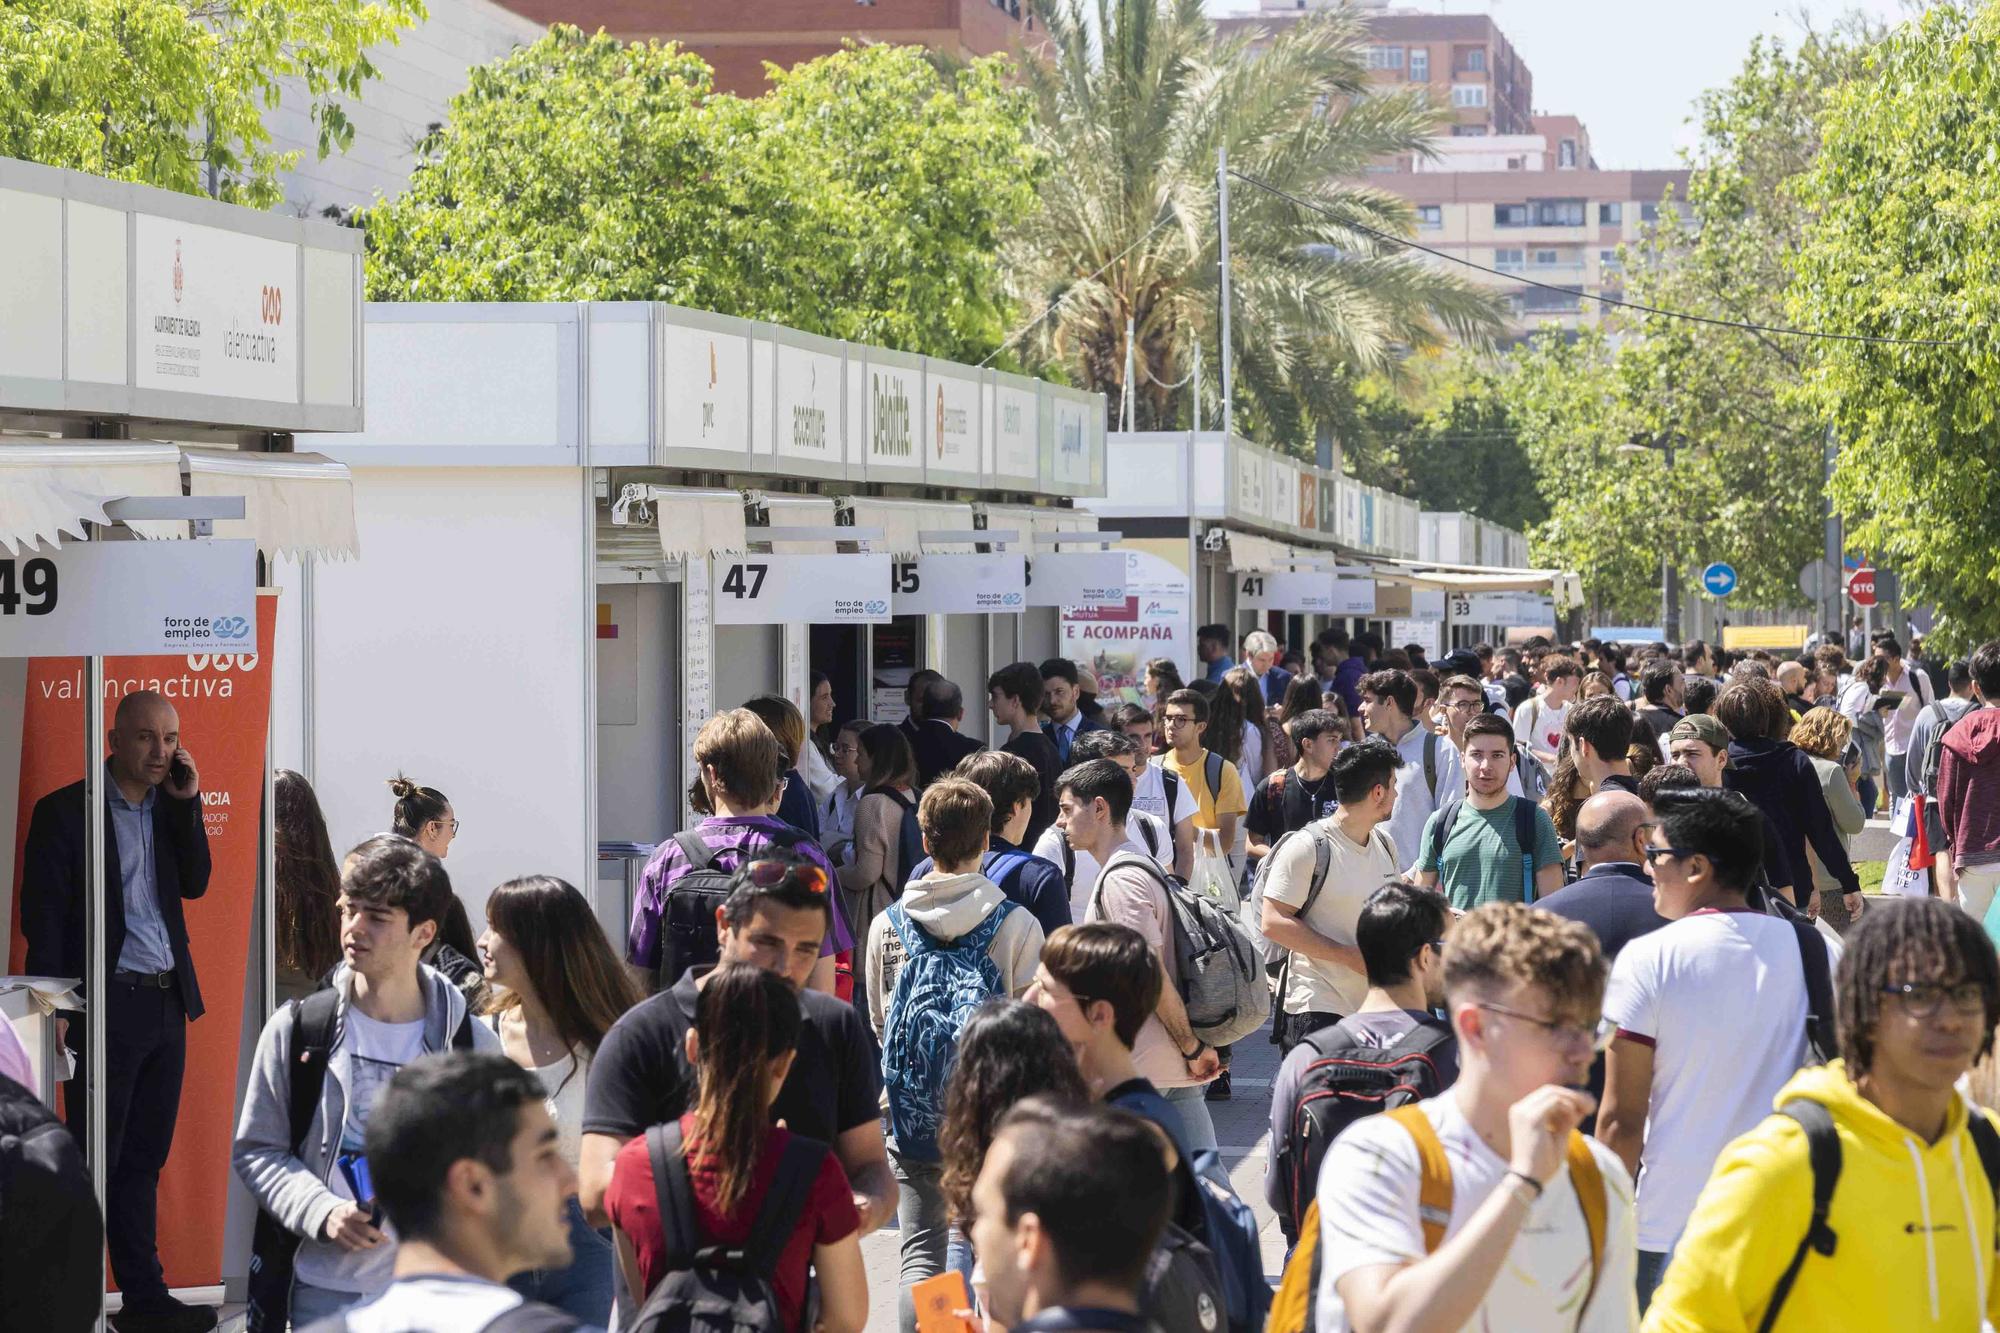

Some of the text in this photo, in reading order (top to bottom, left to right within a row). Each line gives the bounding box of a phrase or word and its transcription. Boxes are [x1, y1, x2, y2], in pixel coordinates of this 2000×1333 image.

[0, 557, 58, 616] 49
[721, 564, 769, 599] 47
[1241, 577, 1264, 597] 41
[1852, 582, 1876, 594] STO
[992, 592, 1002, 600] de
[834, 606, 864, 616] empleo
[1454, 602, 1471, 616] 33
[164, 616, 191, 627] foro
[193, 616, 210, 627] de
[164, 628, 211, 641] empleo
[1063, 623, 1174, 640] E ACOMPAÑA
[41, 669, 234, 699] valnciactiva
